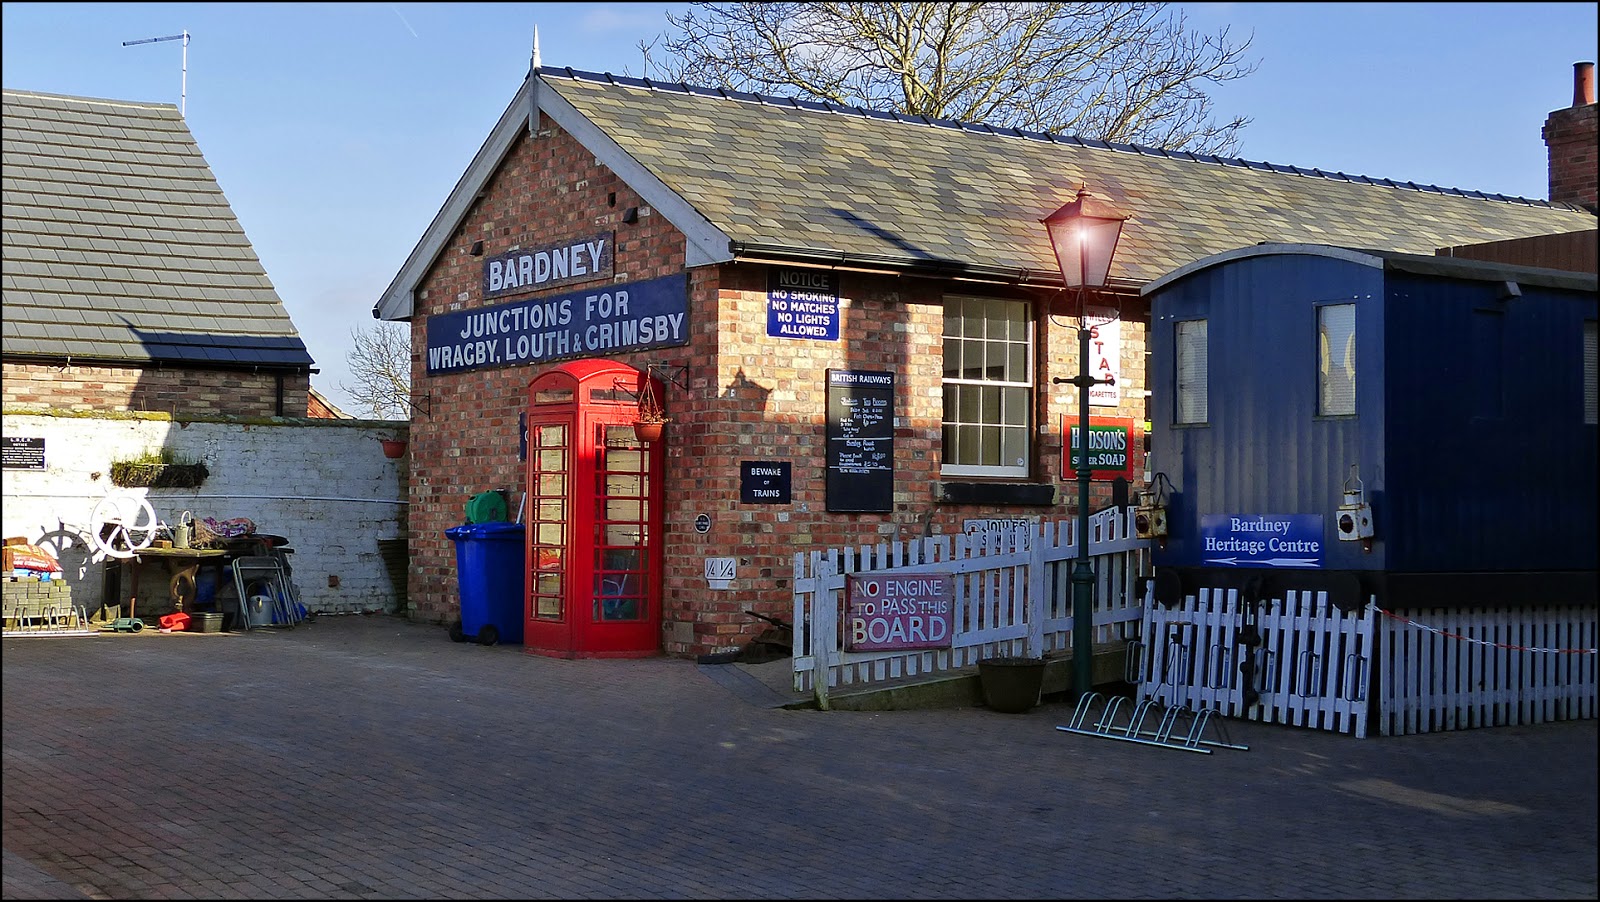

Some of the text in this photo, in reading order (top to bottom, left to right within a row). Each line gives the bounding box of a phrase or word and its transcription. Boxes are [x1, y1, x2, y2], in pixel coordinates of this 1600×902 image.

[489, 239, 605, 291] BARDNEY
[779, 271, 829, 288] NOTICE
[772, 289, 836, 303] NO SMOKING
[461, 290, 629, 340] JUNCTIONS FOR
[772, 301, 835, 314] NO MATCHES
[777, 313, 830, 326] NO LIGHTS
[780, 324, 829, 337] ALLOWED.
[429, 313, 684, 370] WRAGBY, LOUTH & GRIMSBY
[831, 373, 892, 385] BRITISH RAILWAYS
[1089, 390, 1117, 399] IGARETTES
[1071, 427, 1126, 451] HDSON'S
[1072, 453, 1126, 466] SER SOAP
[751, 467, 781, 476] BEWARE
[752, 489, 780, 498] TRAINS
[1230, 516, 1291, 536] Bardney
[1205, 537, 1319, 555] Heritage Centre
[855, 580, 942, 598] NO ENGINE
[855, 598, 948, 616] TO PASS THIS
[852, 616, 947, 644] BOARD
